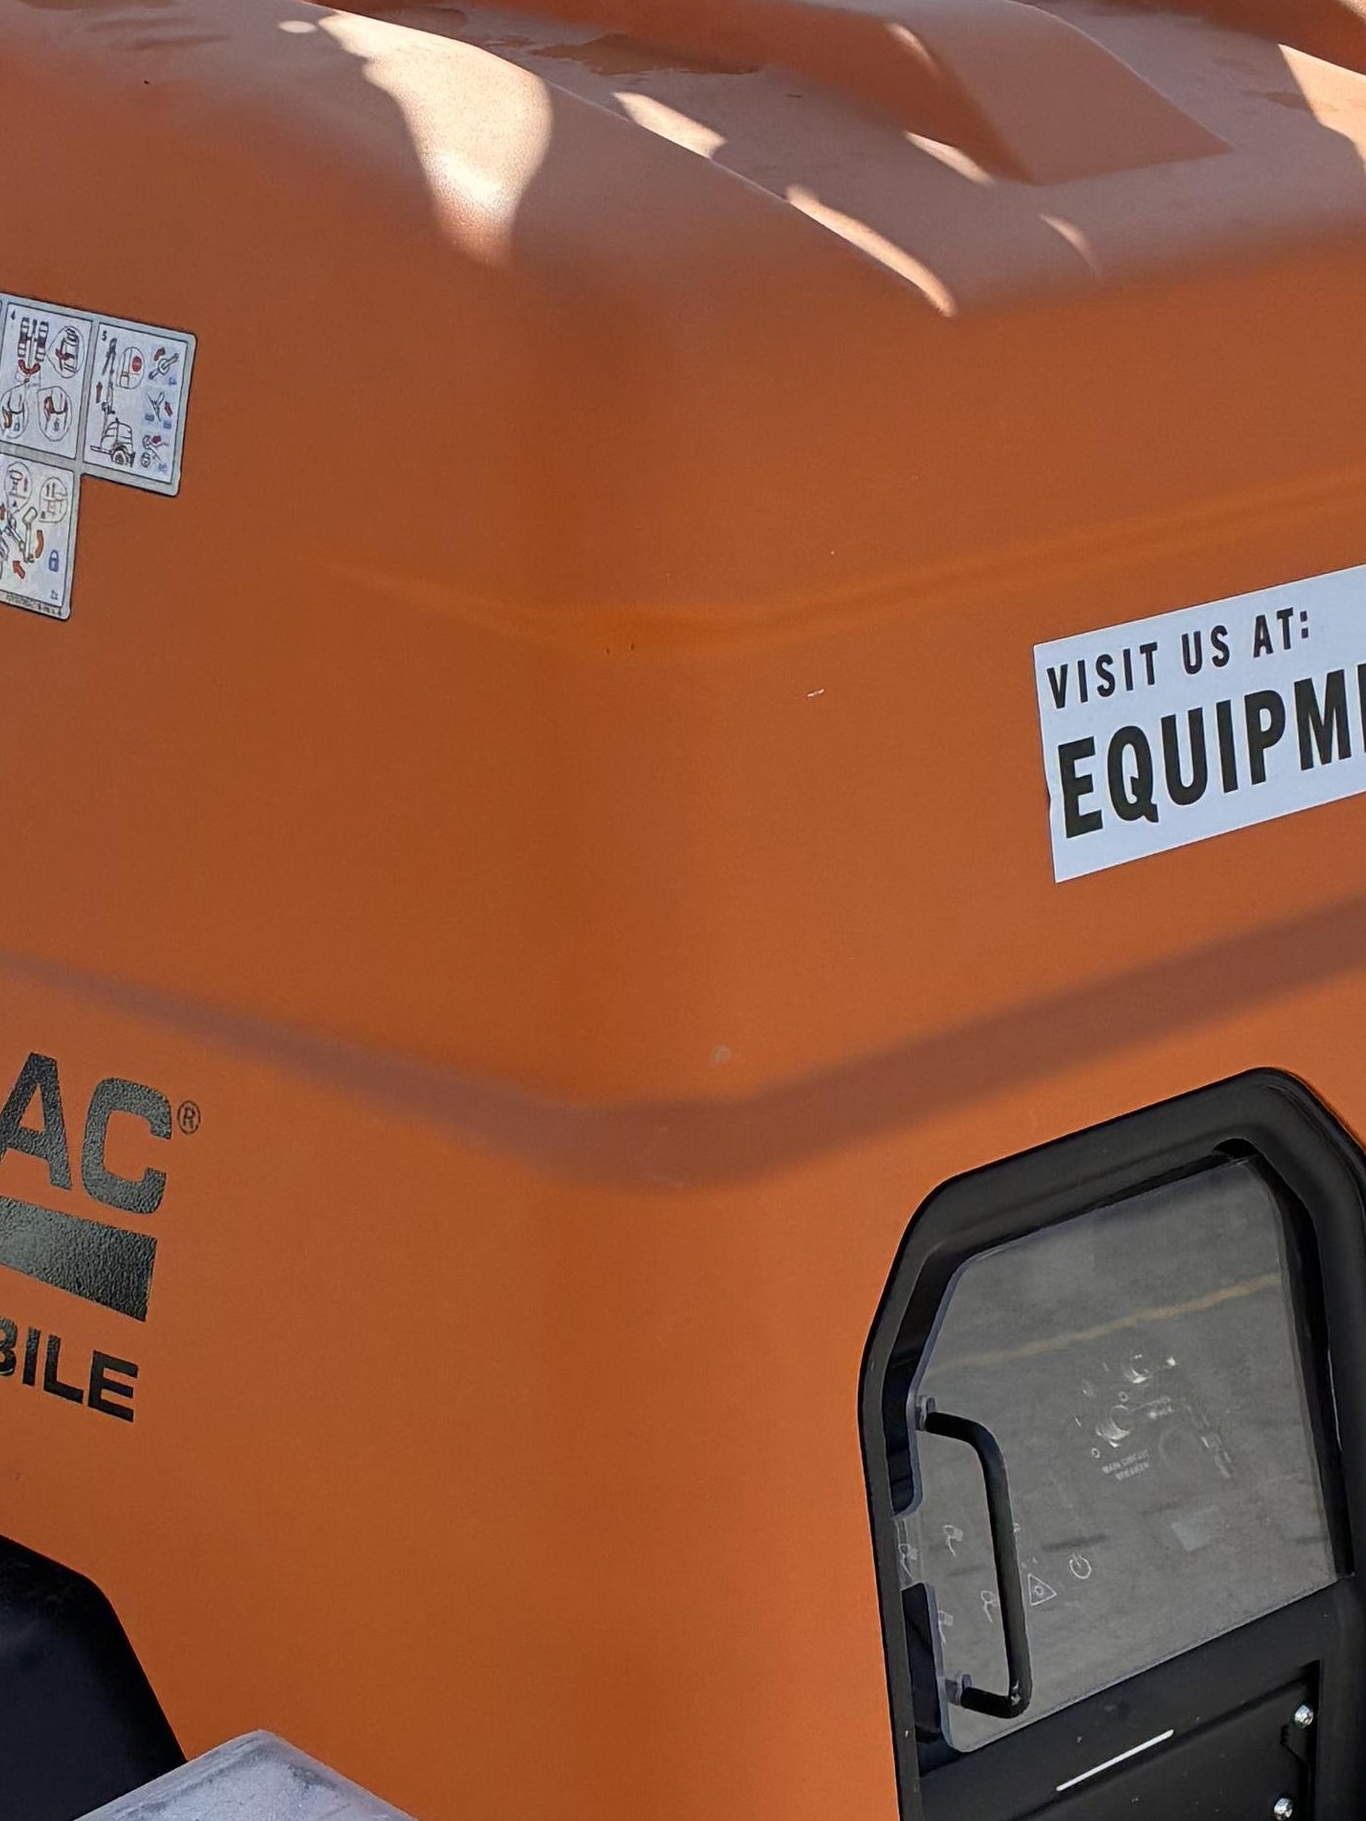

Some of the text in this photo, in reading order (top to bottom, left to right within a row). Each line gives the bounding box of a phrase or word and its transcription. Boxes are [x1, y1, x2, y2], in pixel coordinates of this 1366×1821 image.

[1048, 607, 1311, 710] VISIT US AT:
